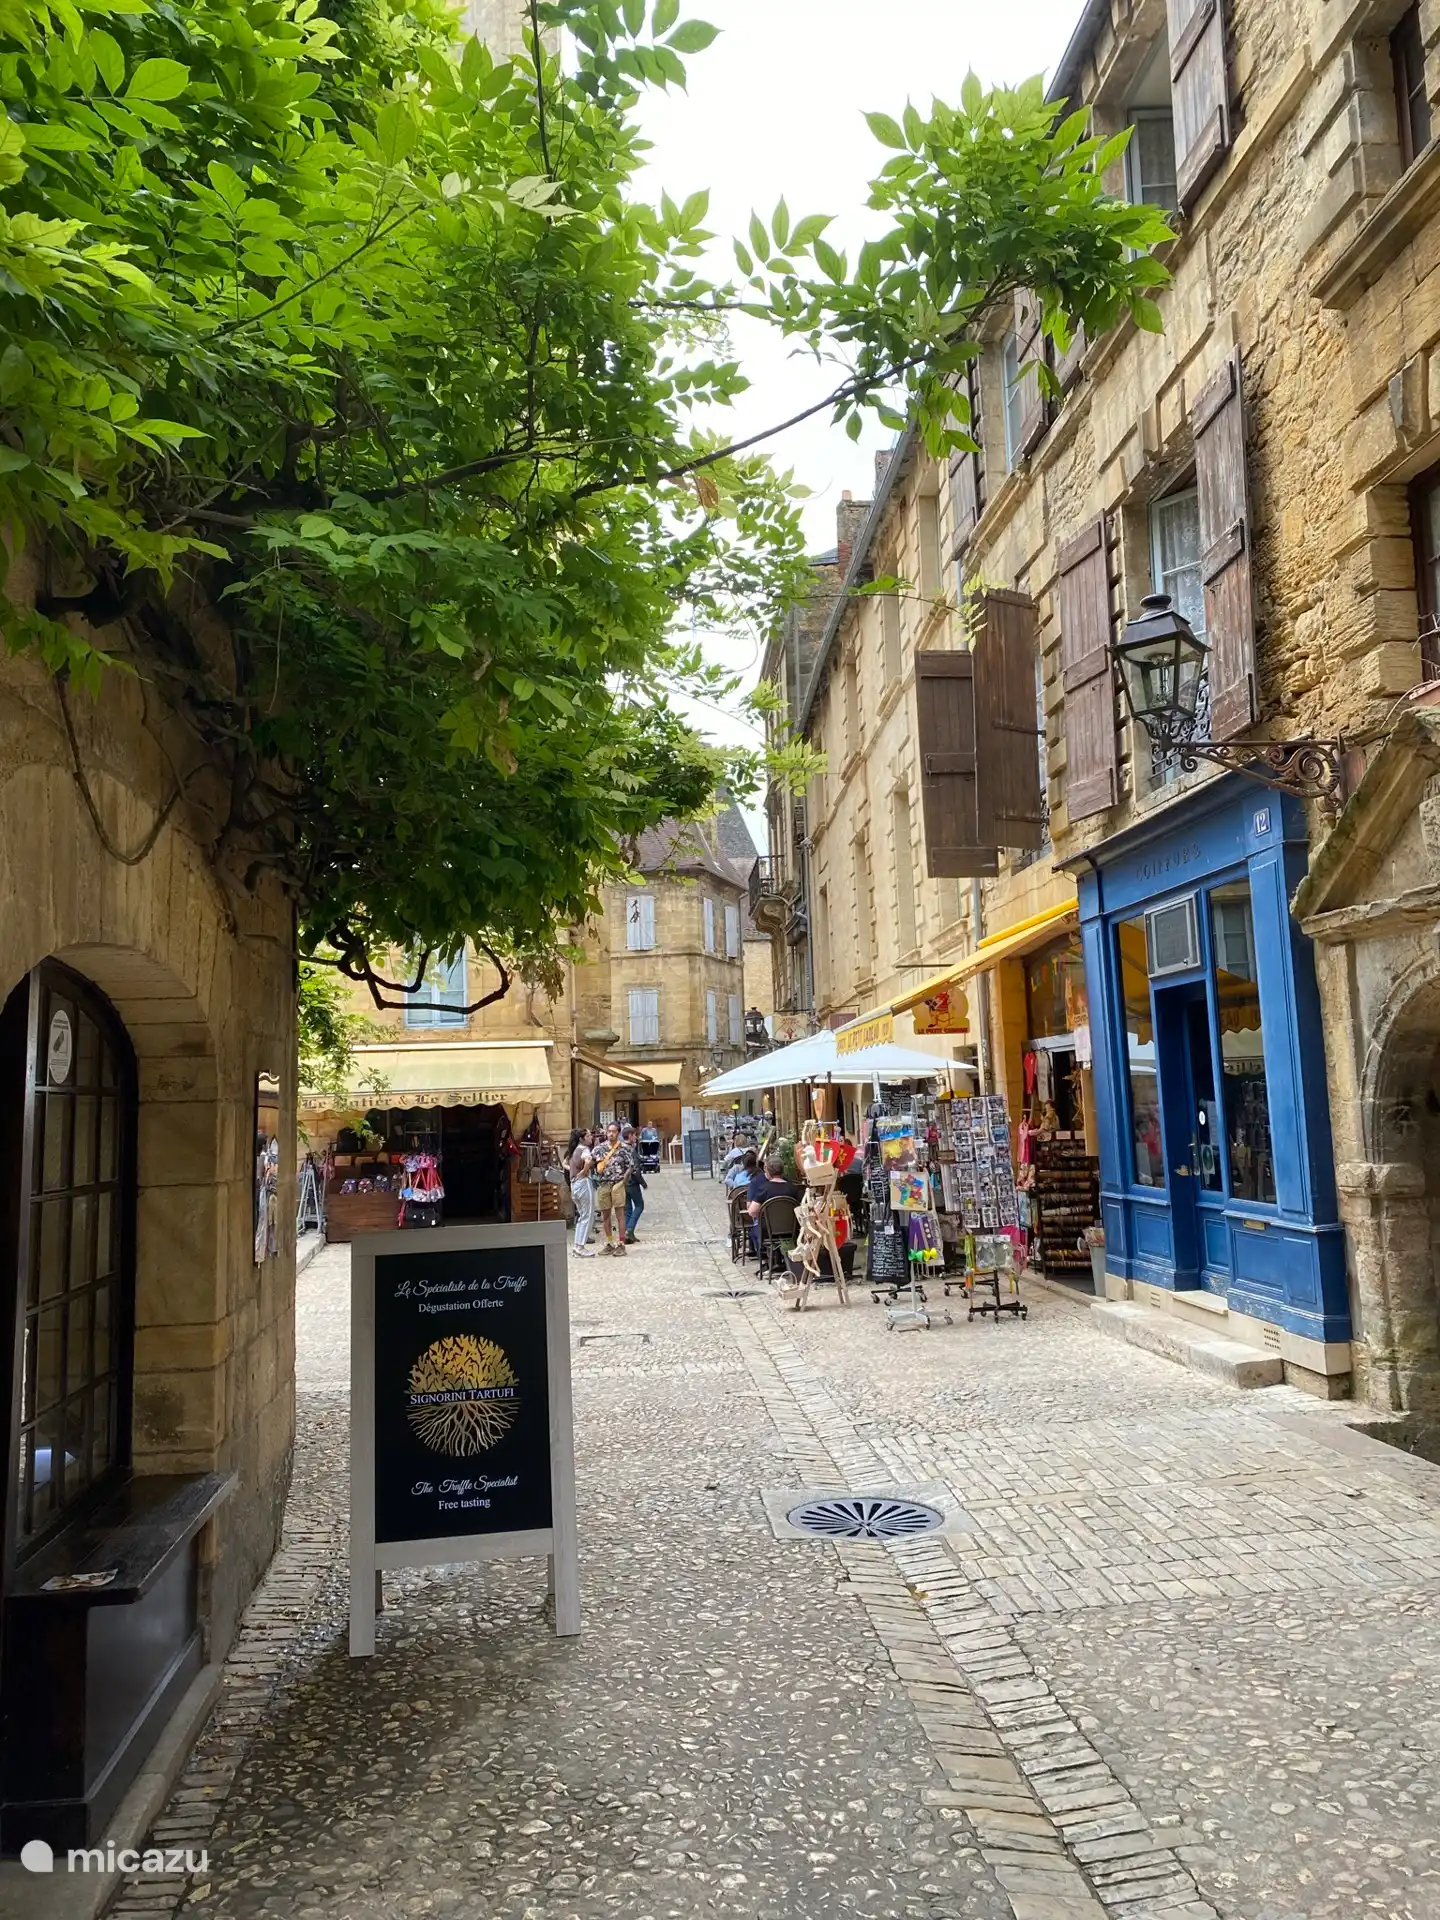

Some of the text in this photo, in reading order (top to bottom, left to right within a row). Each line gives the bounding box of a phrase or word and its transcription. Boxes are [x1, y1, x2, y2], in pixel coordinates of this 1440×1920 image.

[1256, 812, 1267, 833] 12
[302, 1099, 326, 1109] Le
[398, 1095, 408, 1105] &
[413, 1094, 438, 1104] Le
[447, 1091, 508, 1104] Sellier
[394, 1275, 528, 1299] Le Spécialiste de la Truffe
[418, 1298, 504, 1314] Dégustation Offerte
[410, 1387, 514, 1405] SIGNORINI TARTUFI
[411, 1474, 519, 1496] The Truffle Specialist
[438, 1497, 491, 1510] Free tasting
